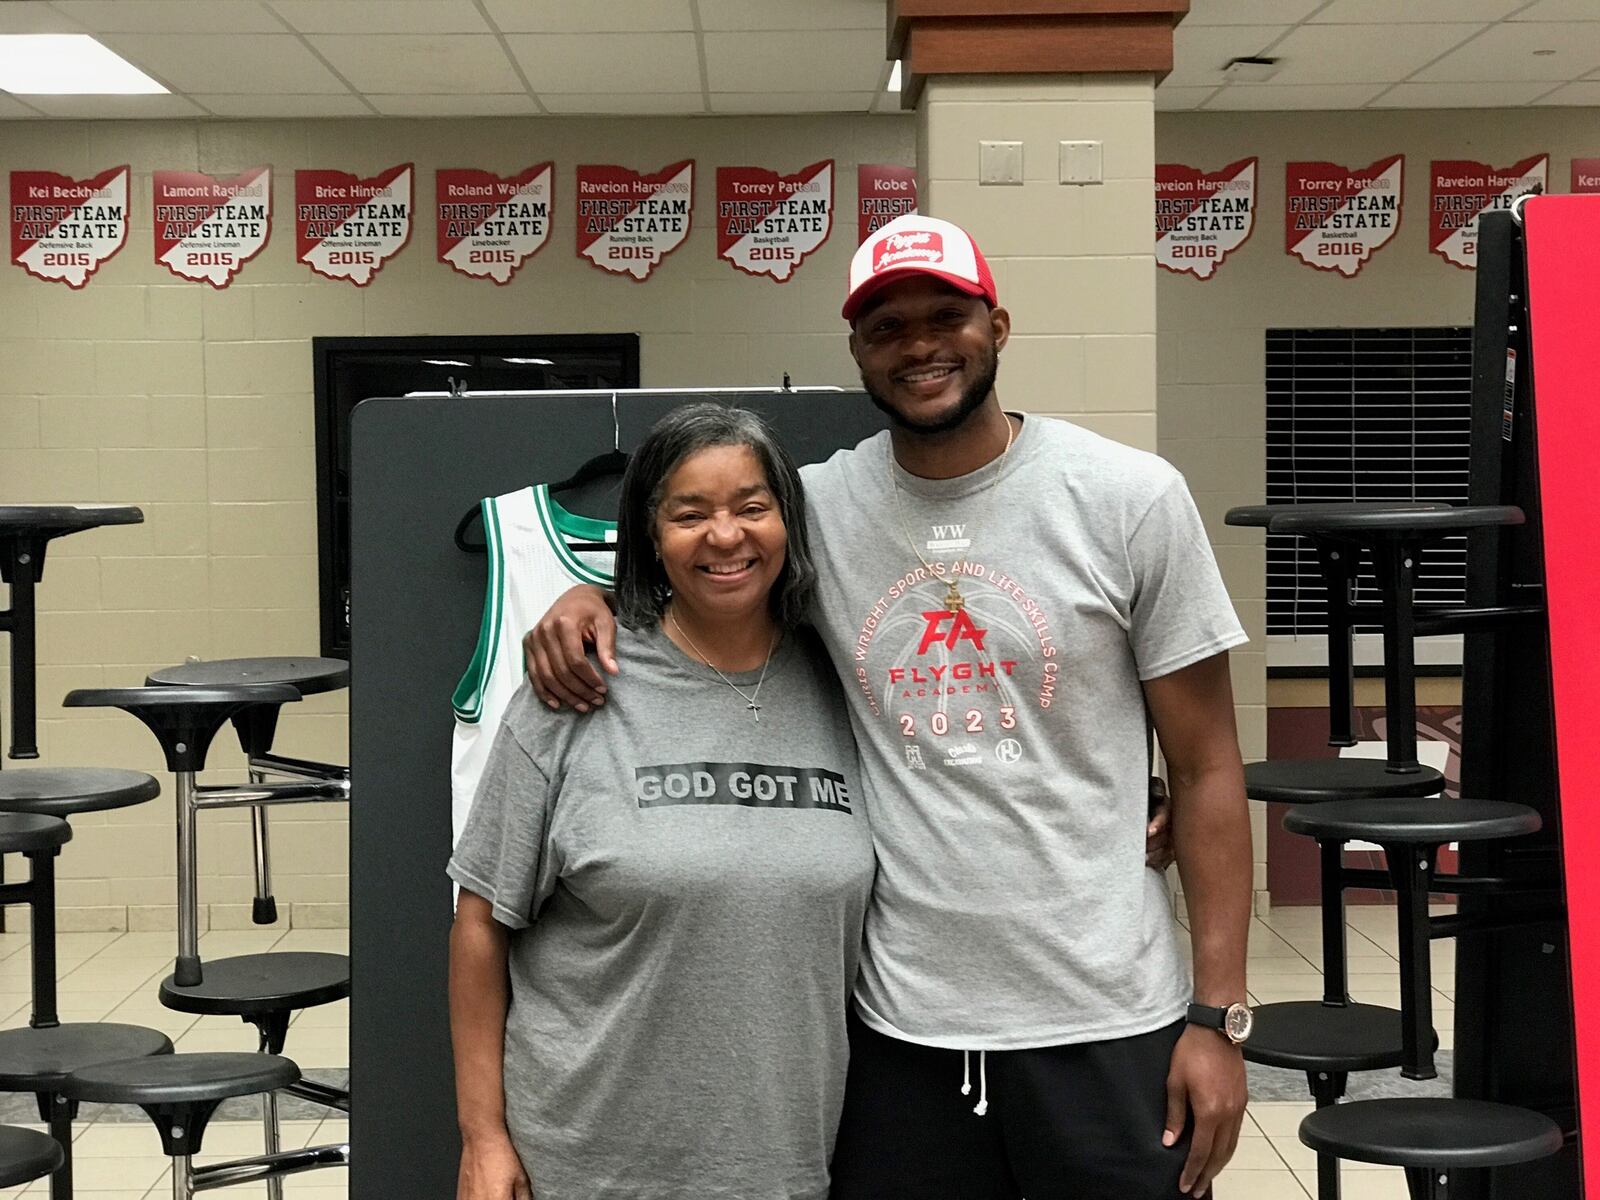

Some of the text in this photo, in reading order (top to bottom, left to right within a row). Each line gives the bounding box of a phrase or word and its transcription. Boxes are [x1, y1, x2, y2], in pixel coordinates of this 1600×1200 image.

[580, 181, 628, 193] Raveion
[732, 181, 820, 195] Torrey Patton
[874, 178, 908, 190] Kobe
[1155, 180, 1194, 191] aveion
[1299, 178, 1390, 192] Torrey Patton
[1437, 176, 1484, 188] Raveion
[28, 186, 112, 198] Kei Beckham
[163, 184, 262, 199] Lamont Ragland
[316, 186, 392, 198] Brice Hinton
[448, 184, 492, 196] Roland
[580, 200, 686, 215] FIRST TEAM
[720, 200, 826, 216] FIRST TEAM
[862, 198, 912, 214] FIRST
[1155, 198, 1249, 214] IRST TEAM
[1290, 196, 1396, 212] FIRST TEAM
[1436, 195, 1486, 210] FIRST
[14, 205, 122, 222] FIRST TEAM
[157, 206, 264, 221] FIRST TEAM
[300, 204, 406, 220] FIRST TEAM
[440, 203, 546, 219] FIRST TEAM
[586, 218, 681, 233] ALL STATE
[728, 218, 822, 234] ALL STATE
[1188, 216, 1244, 231] STATE
[1296, 214, 1390, 230] ALL STATE
[1440, 213, 1474, 228] ALL
[21, 224, 118, 239] ALL STATE
[164, 224, 260, 239] ALL STATE
[306, 222, 401, 238] ALL STATE
[447, 221, 542, 237] ALL STATE
[470, 250, 514, 263] 2015
[608, 246, 654, 259] 2015
[750, 247, 794, 260] 2015
[1172, 246, 1217, 258] 2016
[1318, 243, 1363, 256] 2016
[44, 253, 90, 266] 2015
[187, 253, 232, 266] 2015
[329, 252, 374, 264] 2015
[856, 596, 888, 661] WRIGHT
[888, 562, 946, 599] SPORTS
[951, 560, 985, 576] AND
[988, 570, 1025, 601] LIFE
[1022, 599, 1056, 658] SKILLS
[1040, 662, 1058, 708] CAMP
[917, 608, 988, 656] FA
[888, 661, 1018, 684] FLYGHT
[902, 684, 1001, 698] ACADEMY
[636, 771, 851, 806] GOD GOT ME
